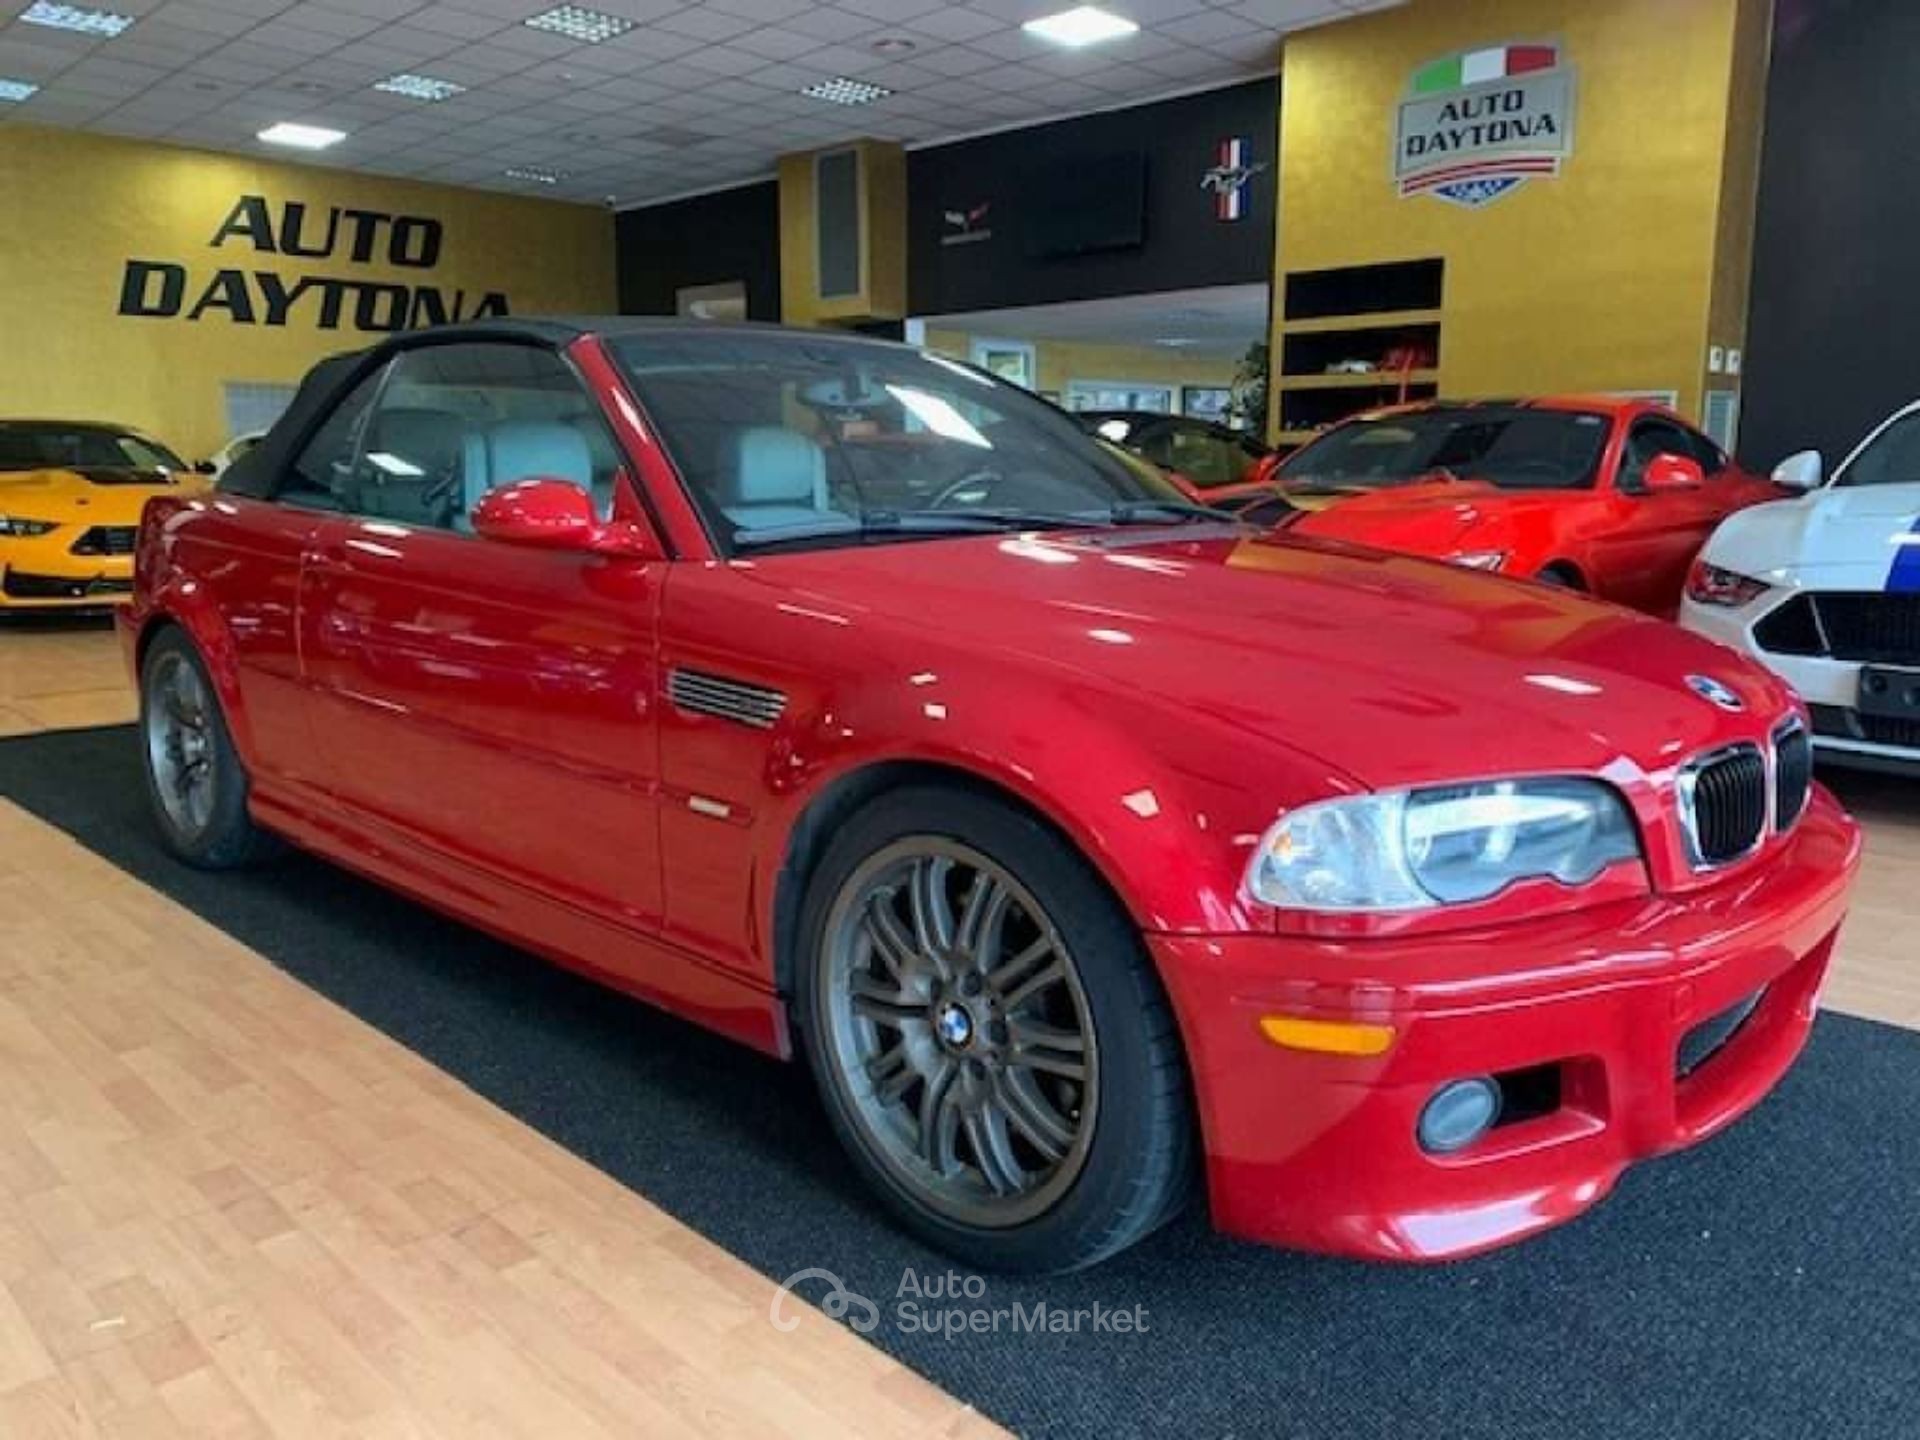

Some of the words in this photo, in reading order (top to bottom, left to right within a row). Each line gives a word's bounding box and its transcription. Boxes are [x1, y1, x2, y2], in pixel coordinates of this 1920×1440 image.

[1437, 89, 1525, 124] AUTO
[1406, 113, 1556, 157] DAYTONA
[210, 195, 443, 268] AUTO
